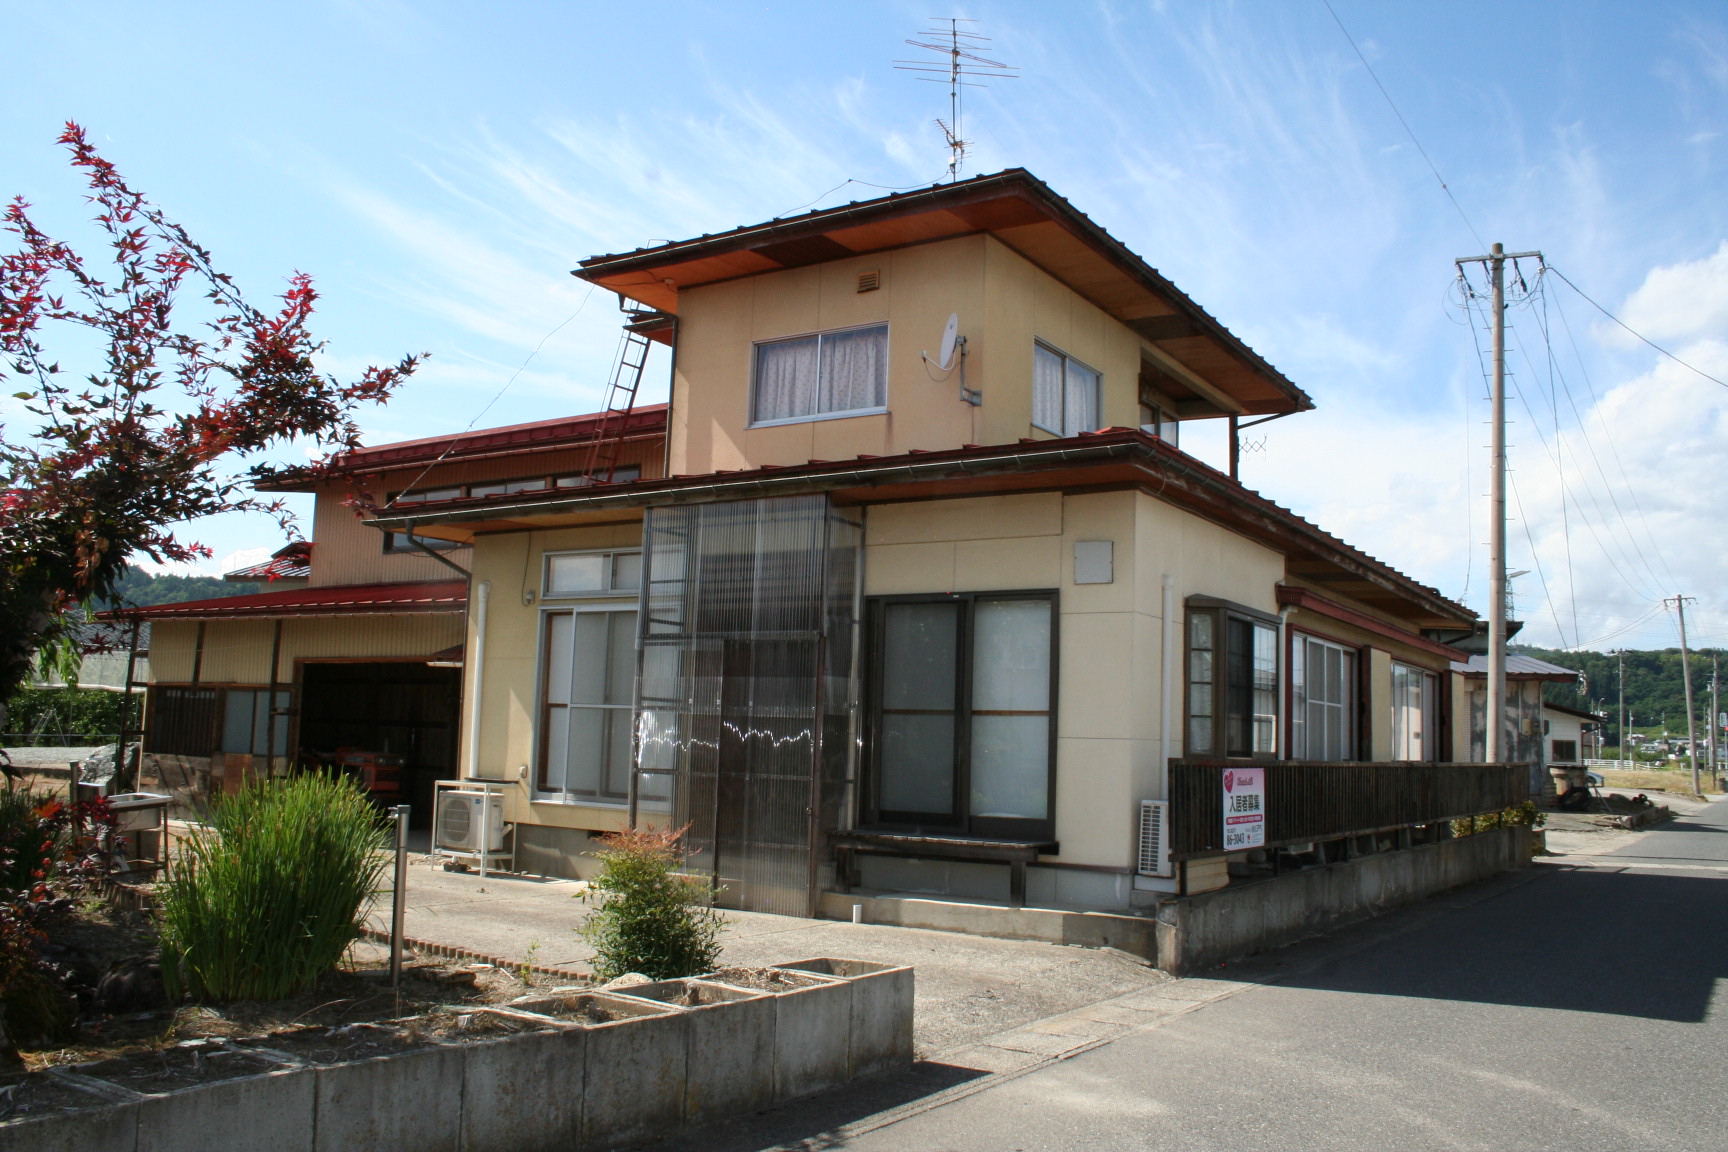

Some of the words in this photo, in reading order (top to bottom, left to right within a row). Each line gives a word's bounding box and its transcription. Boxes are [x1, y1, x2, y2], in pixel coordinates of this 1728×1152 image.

[1230, 794, 1260, 813] 入居者募集
